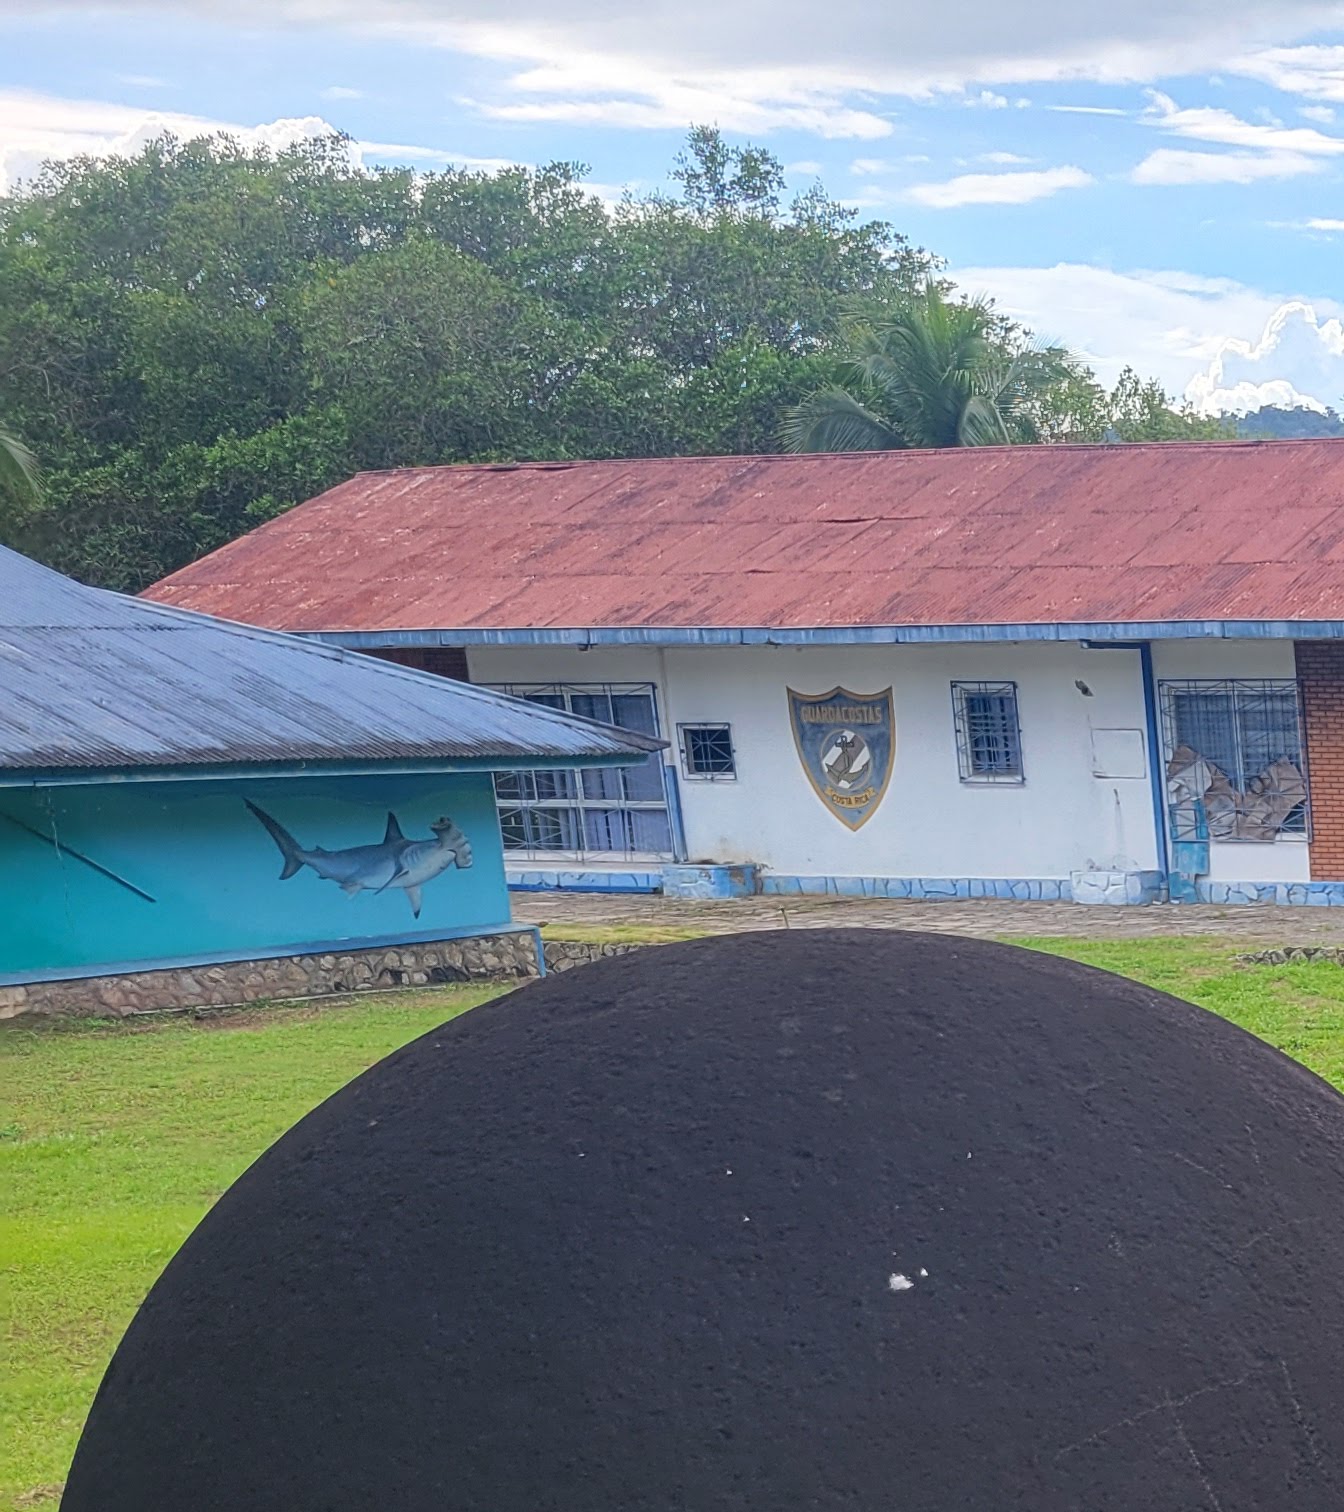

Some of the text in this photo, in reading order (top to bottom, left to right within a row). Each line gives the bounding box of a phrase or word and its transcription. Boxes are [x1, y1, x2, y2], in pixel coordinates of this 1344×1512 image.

[800, 705, 883, 723] GUARDACOSTAS
[831, 793, 870, 805] COSTA RICA
